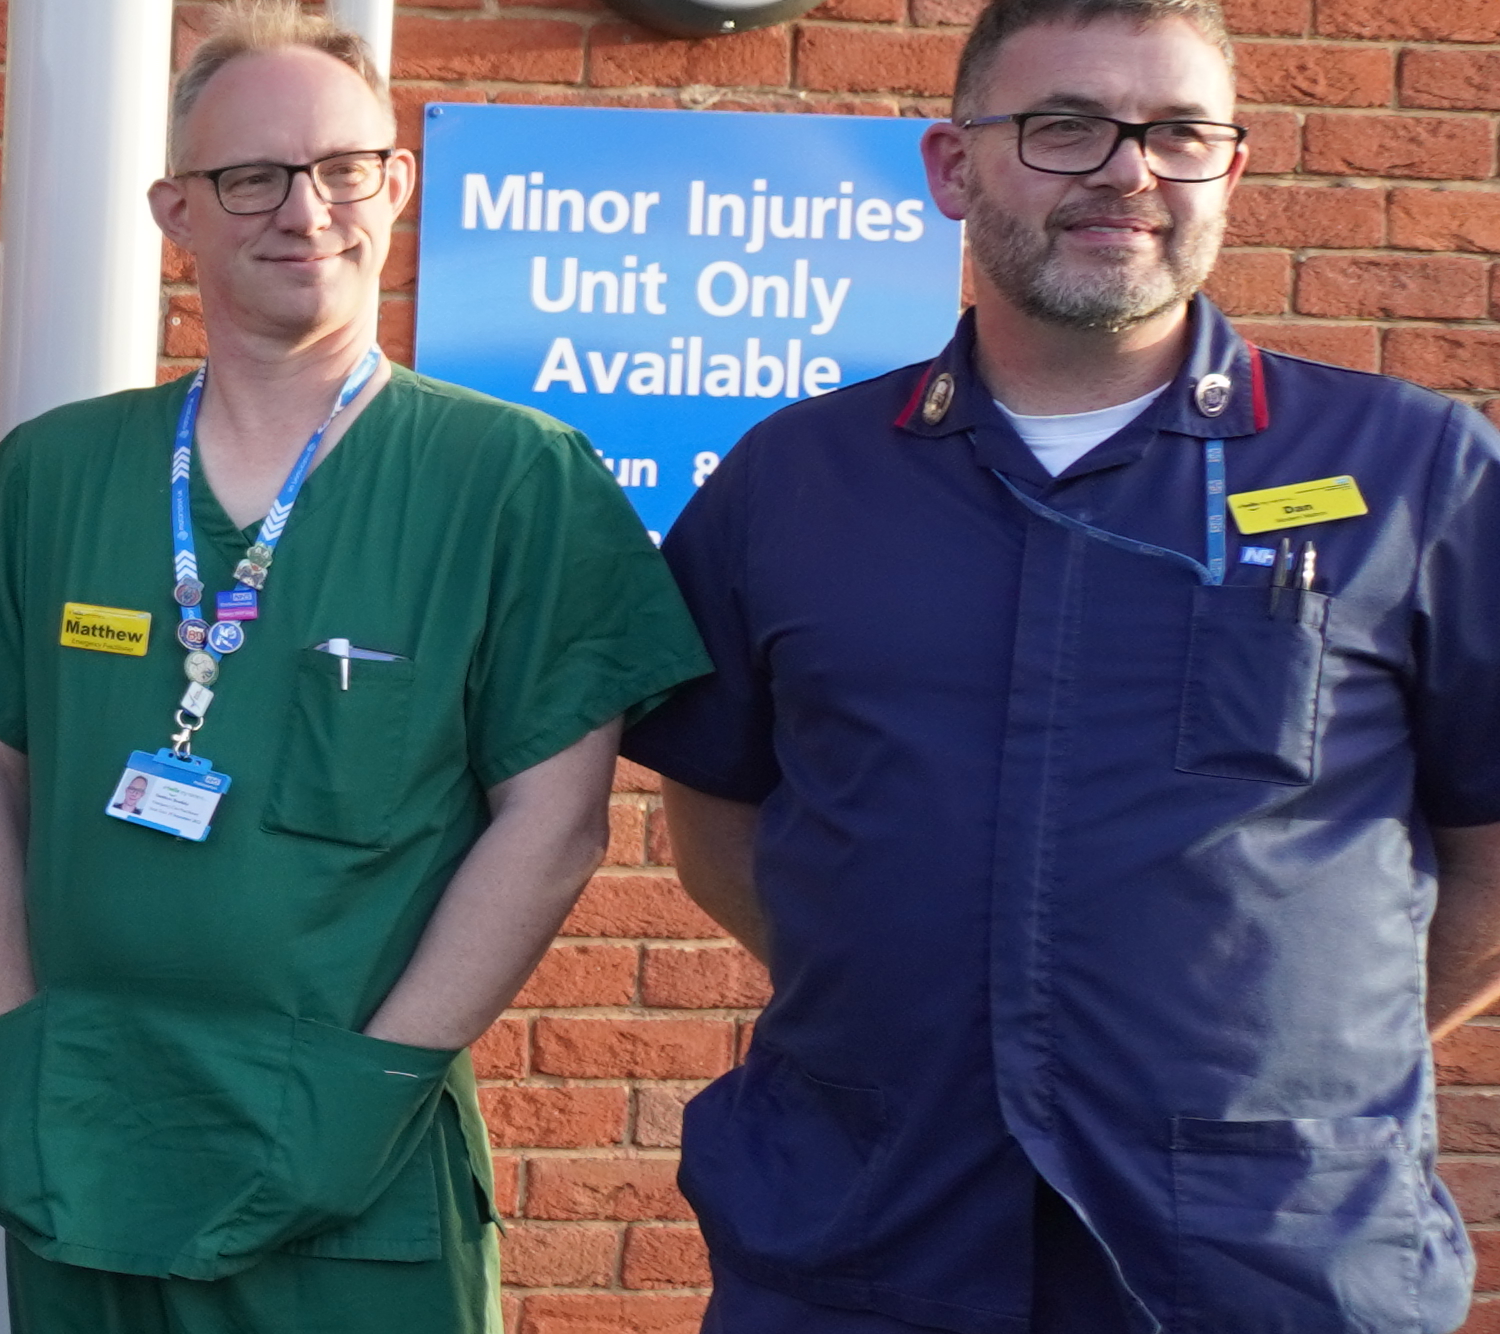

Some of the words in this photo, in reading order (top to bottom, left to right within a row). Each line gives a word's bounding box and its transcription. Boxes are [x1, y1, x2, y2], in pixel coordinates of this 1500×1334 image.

[462, 172, 660, 235] Minor
[689, 179, 925, 255] Injuries
[530, 255, 667, 315] Unit
[697, 258, 851, 335] Only
[533, 336, 841, 398] Available
[595, 449, 657, 487] un
[65, 619, 144, 643] Matthew
